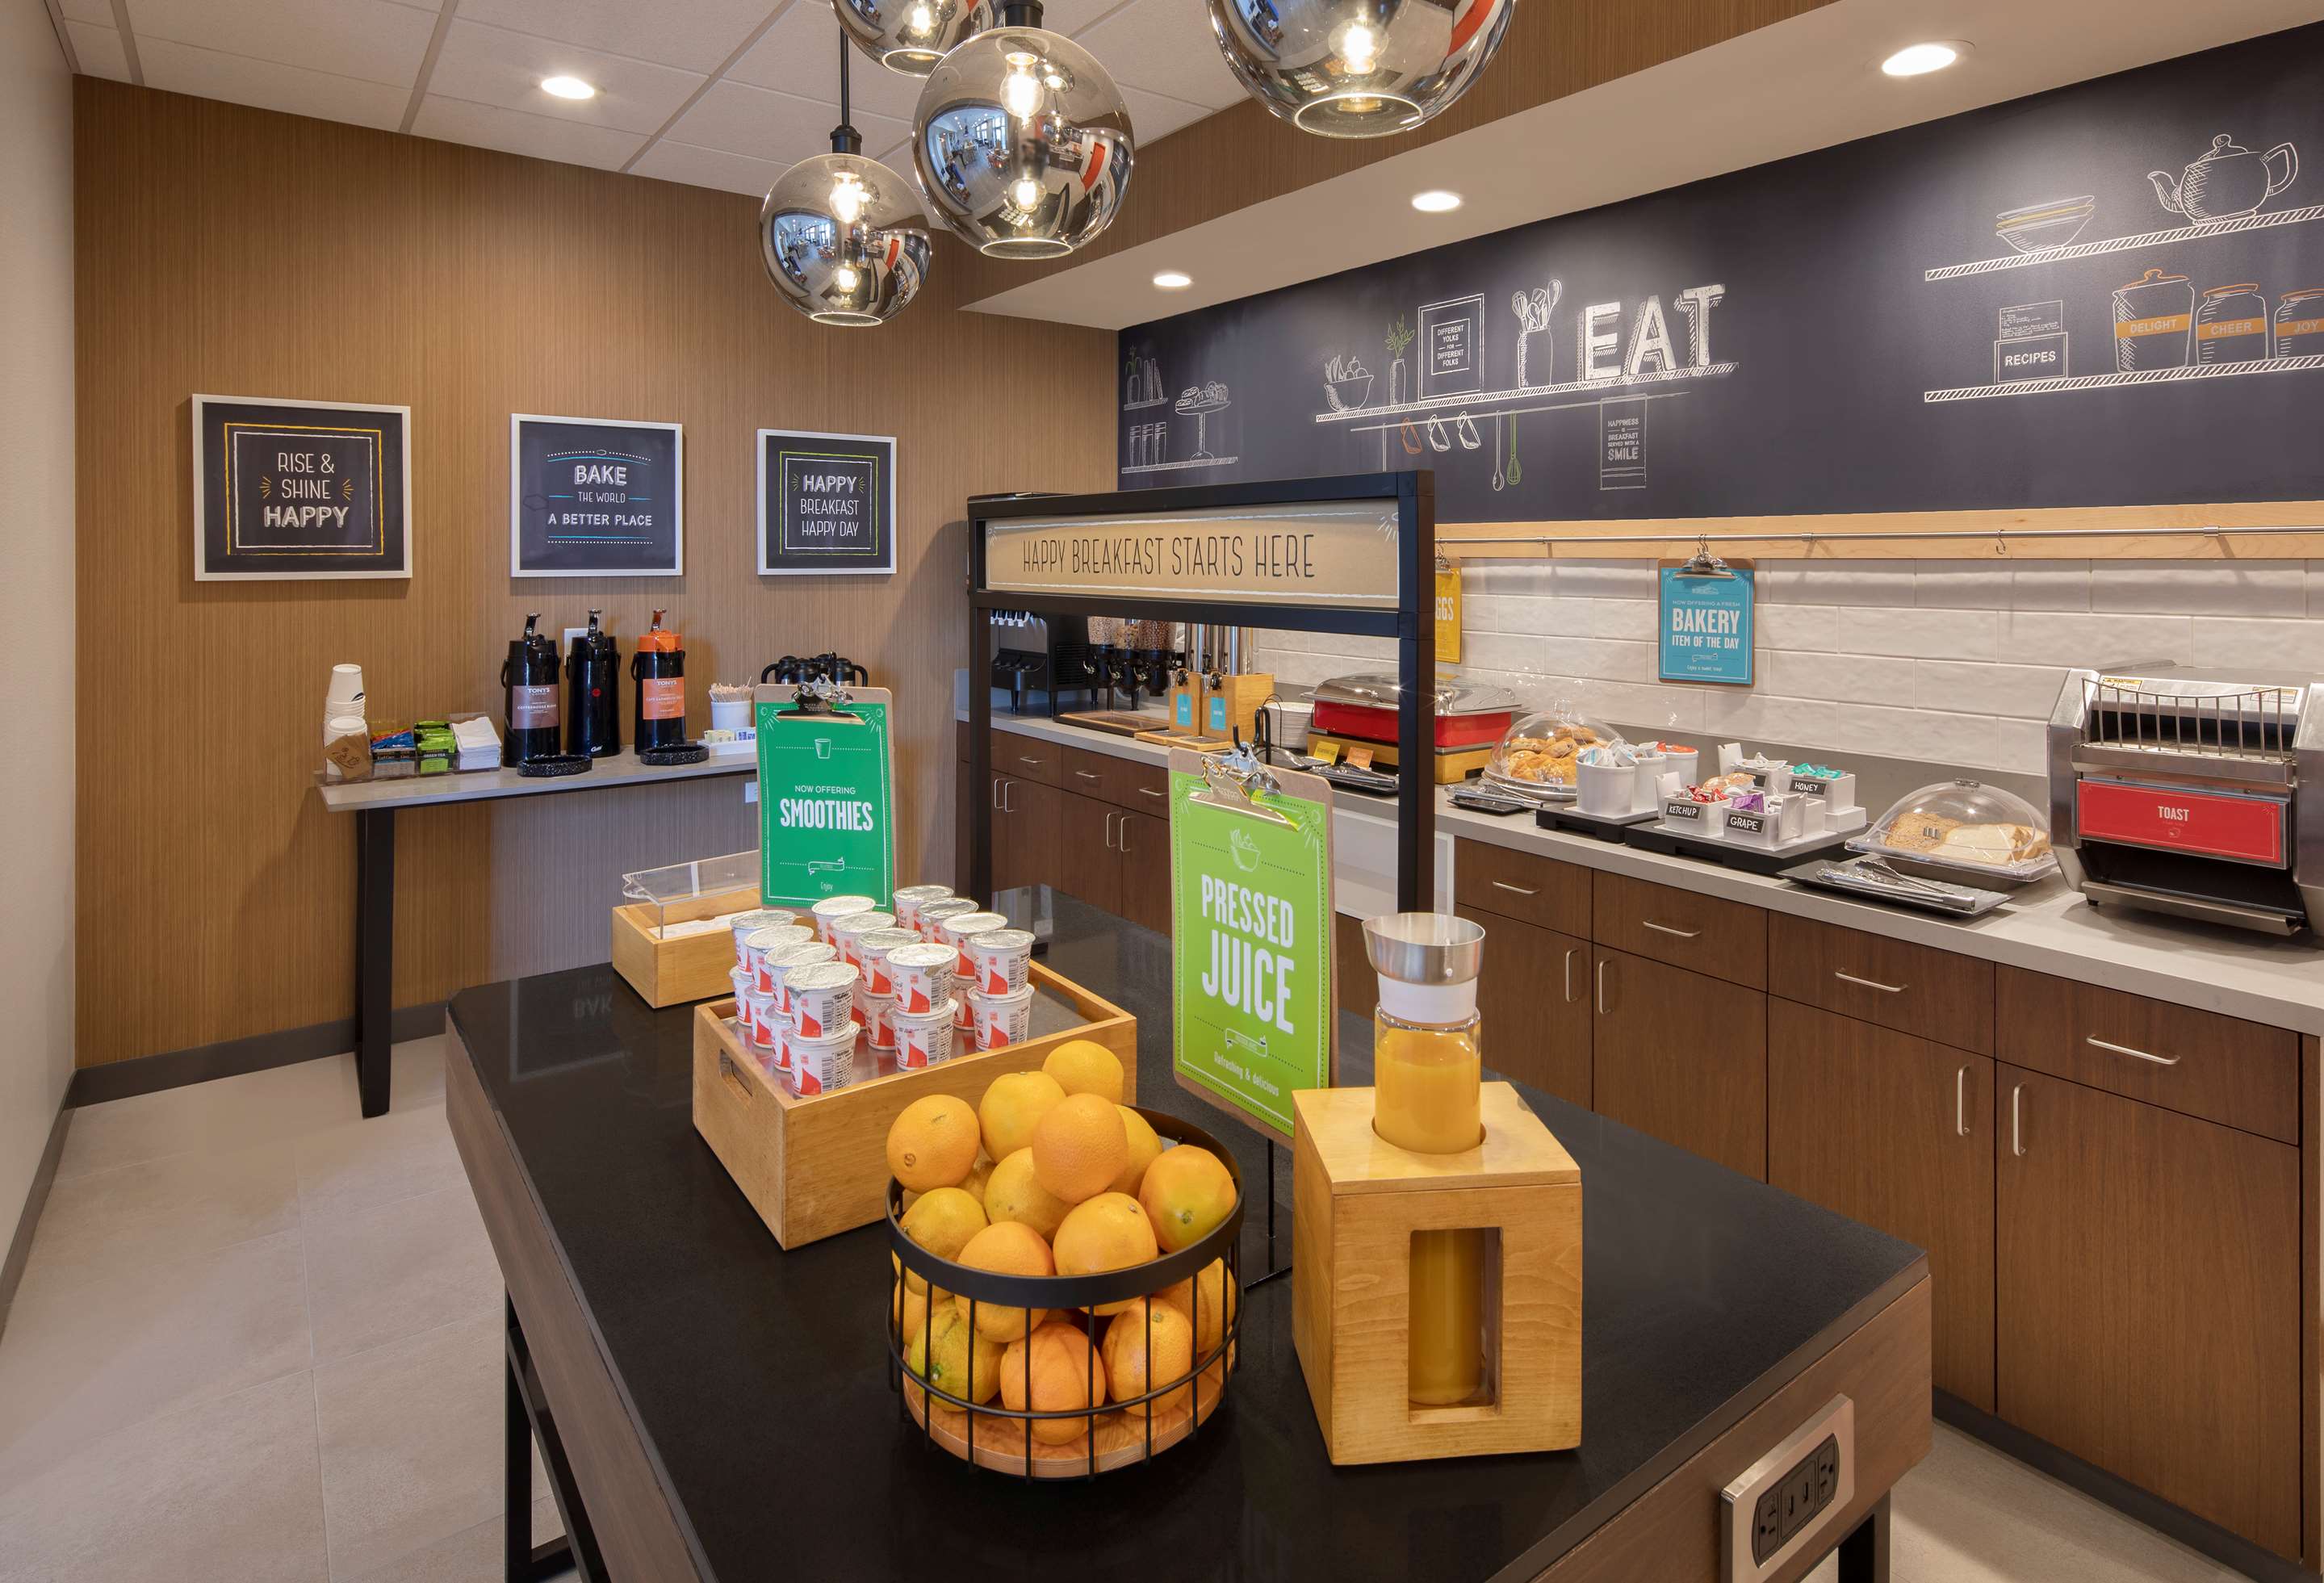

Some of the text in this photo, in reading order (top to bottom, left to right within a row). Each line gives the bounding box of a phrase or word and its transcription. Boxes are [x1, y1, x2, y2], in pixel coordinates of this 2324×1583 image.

[1437, 325, 1464, 336] DIFFERENT
[1577, 283, 1726, 383] EAT
[2130, 319, 2177, 333] DELIGHT
[2210, 321, 2253, 335] CHEER
[2294, 320, 2319, 334] JOY
[1443, 333, 1459, 342] YOLKS
[1437, 349, 1464, 360] DIFFERENT
[1443, 358, 1459, 366] FOLKS
[2005, 350, 2056, 366] RECIPES
[1607, 418, 1639, 427] HAPPINESS
[1608, 433, 1639, 442] BREAKFAST
[1607, 446, 1639, 461] SMILE
[278, 453, 334, 473] RISE &
[574, 465, 627, 486] BAKE
[282, 479, 331, 499] SHINE
[803, 475, 857, 493] HAPPY
[578, 492, 626, 504] THE WORLD
[800, 499, 859, 515] BREAKFAST
[263, 505, 349, 528] HAPPY
[548, 513, 652, 526] A BETTER PLACE
[802, 521, 859, 536] HAPPY DAY
[1023, 534, 1315, 578] HAPPY BREAKFAST STARTS HERE
[1434, 597, 1454, 621] GGS
[1673, 608, 1740, 634] BAKERY
[1672, 634, 1740, 649] ITEM OF THE DAY
[795, 785, 856, 795] NOW OFFERING
[1794, 781, 1819, 791] HONEY
[780, 798, 873, 831] SMOOTHIES
[1669, 805, 1697, 815] KETCHUP
[2157, 806, 2189, 822] TOAST
[1730, 817, 1759, 831] GRAPE
[820, 882, 833, 892] Enjoy
[1201, 873, 1294, 949] PRESSED
[1201, 929, 1295, 1036] JUICE
[1214, 1050, 1279, 1097] Refreshing & delicious
